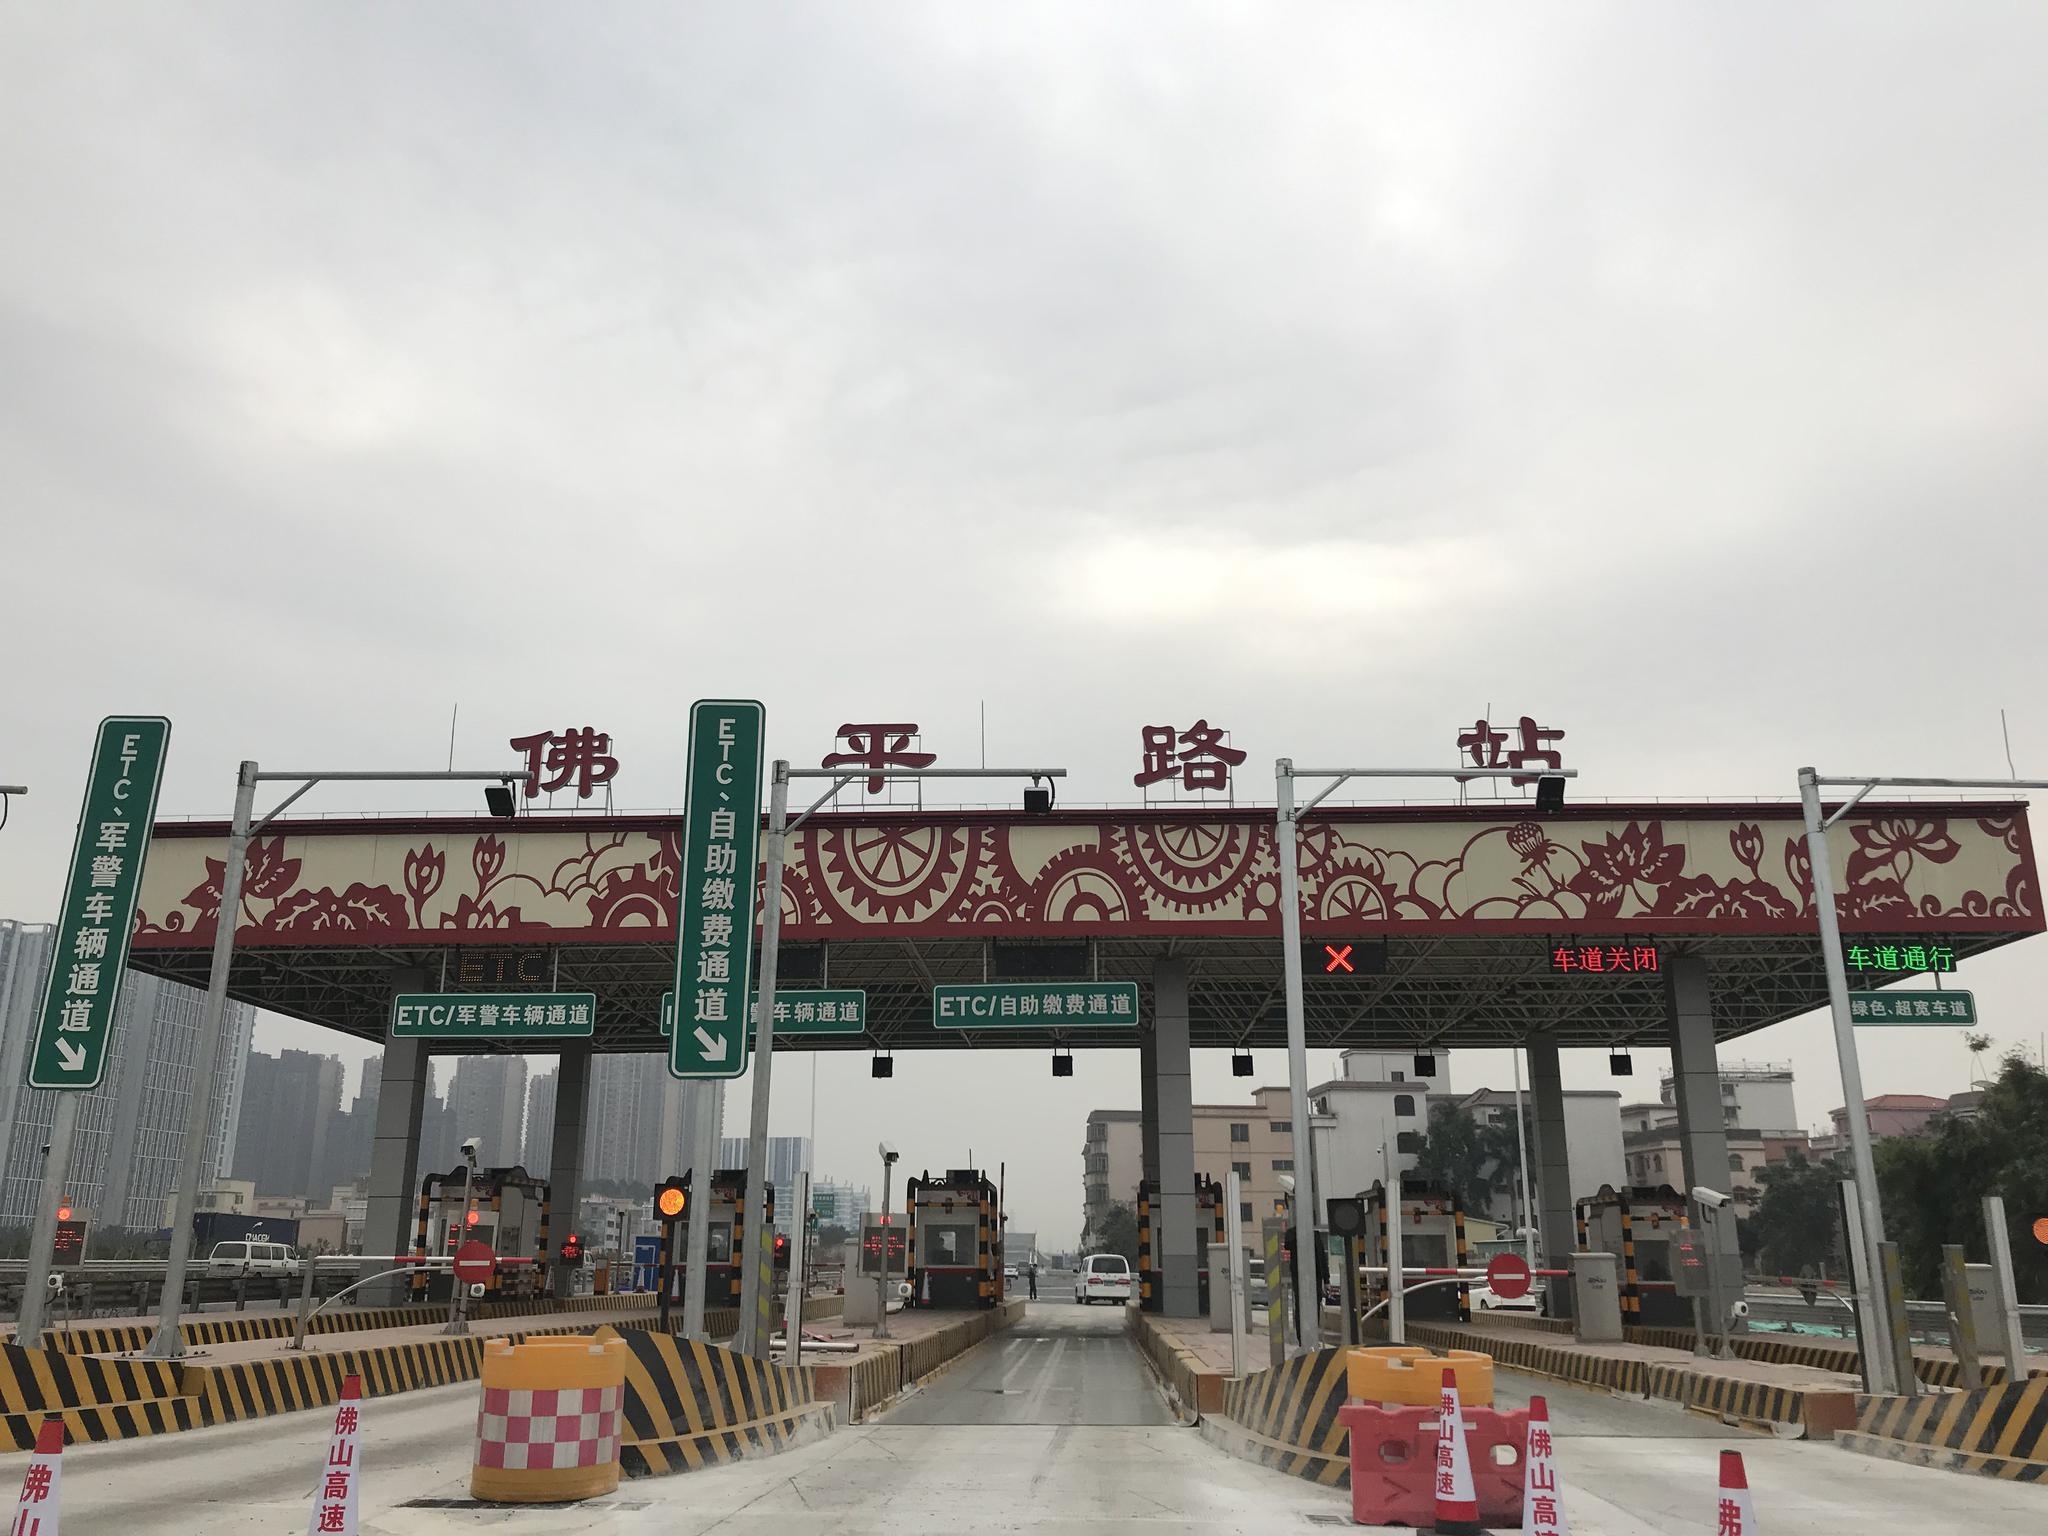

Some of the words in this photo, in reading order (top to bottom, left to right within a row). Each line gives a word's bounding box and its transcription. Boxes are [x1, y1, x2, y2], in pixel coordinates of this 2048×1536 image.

[58, 734, 140, 1033] ETC、军警车辆通道
[695, 717, 737, 1022] ETC、自助缴费通道
[459, 952, 543, 983] ETC
[1552, 945, 1659, 974] 车道关闭
[1847, 945, 1954, 972] 车道通行
[397, 1004, 590, 1027] ETC/军警车辆通道
[939, 993, 1132, 1017] ETC/自助缴费通道
[1851, 1000, 1968, 1017] 绿色、超宽车道
[1436, 1393, 1456, 1496] 佛山高速
[317, 1406, 359, 1533] 佛山高速
